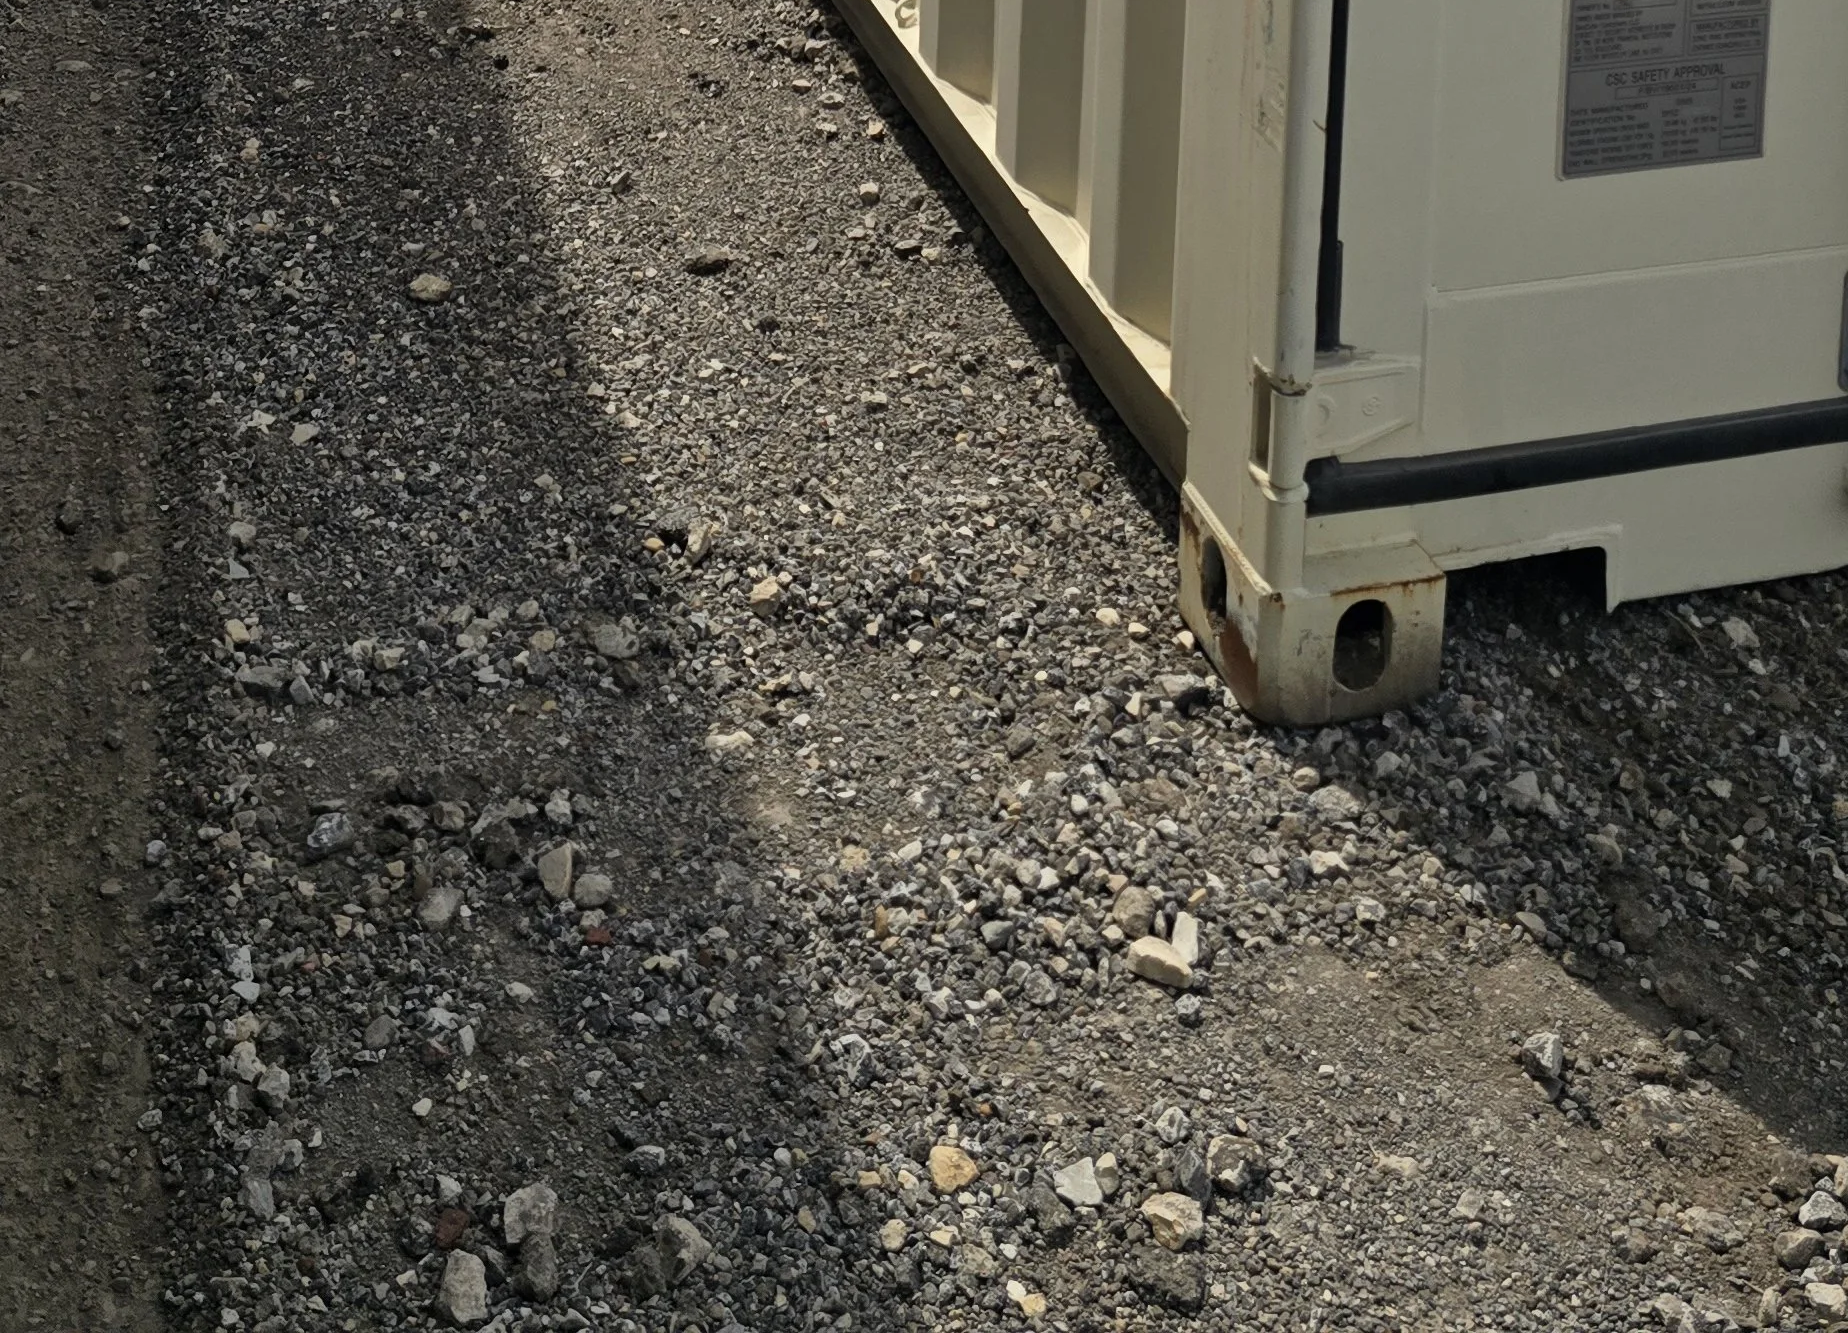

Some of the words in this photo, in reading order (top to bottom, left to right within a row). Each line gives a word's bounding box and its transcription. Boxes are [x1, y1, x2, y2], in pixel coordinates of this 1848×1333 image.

[1606, 72, 1627, 86] CSC
[1631, 68, 1671, 84] SAFETY
[1674, 63, 1726, 78] APPROVAL
